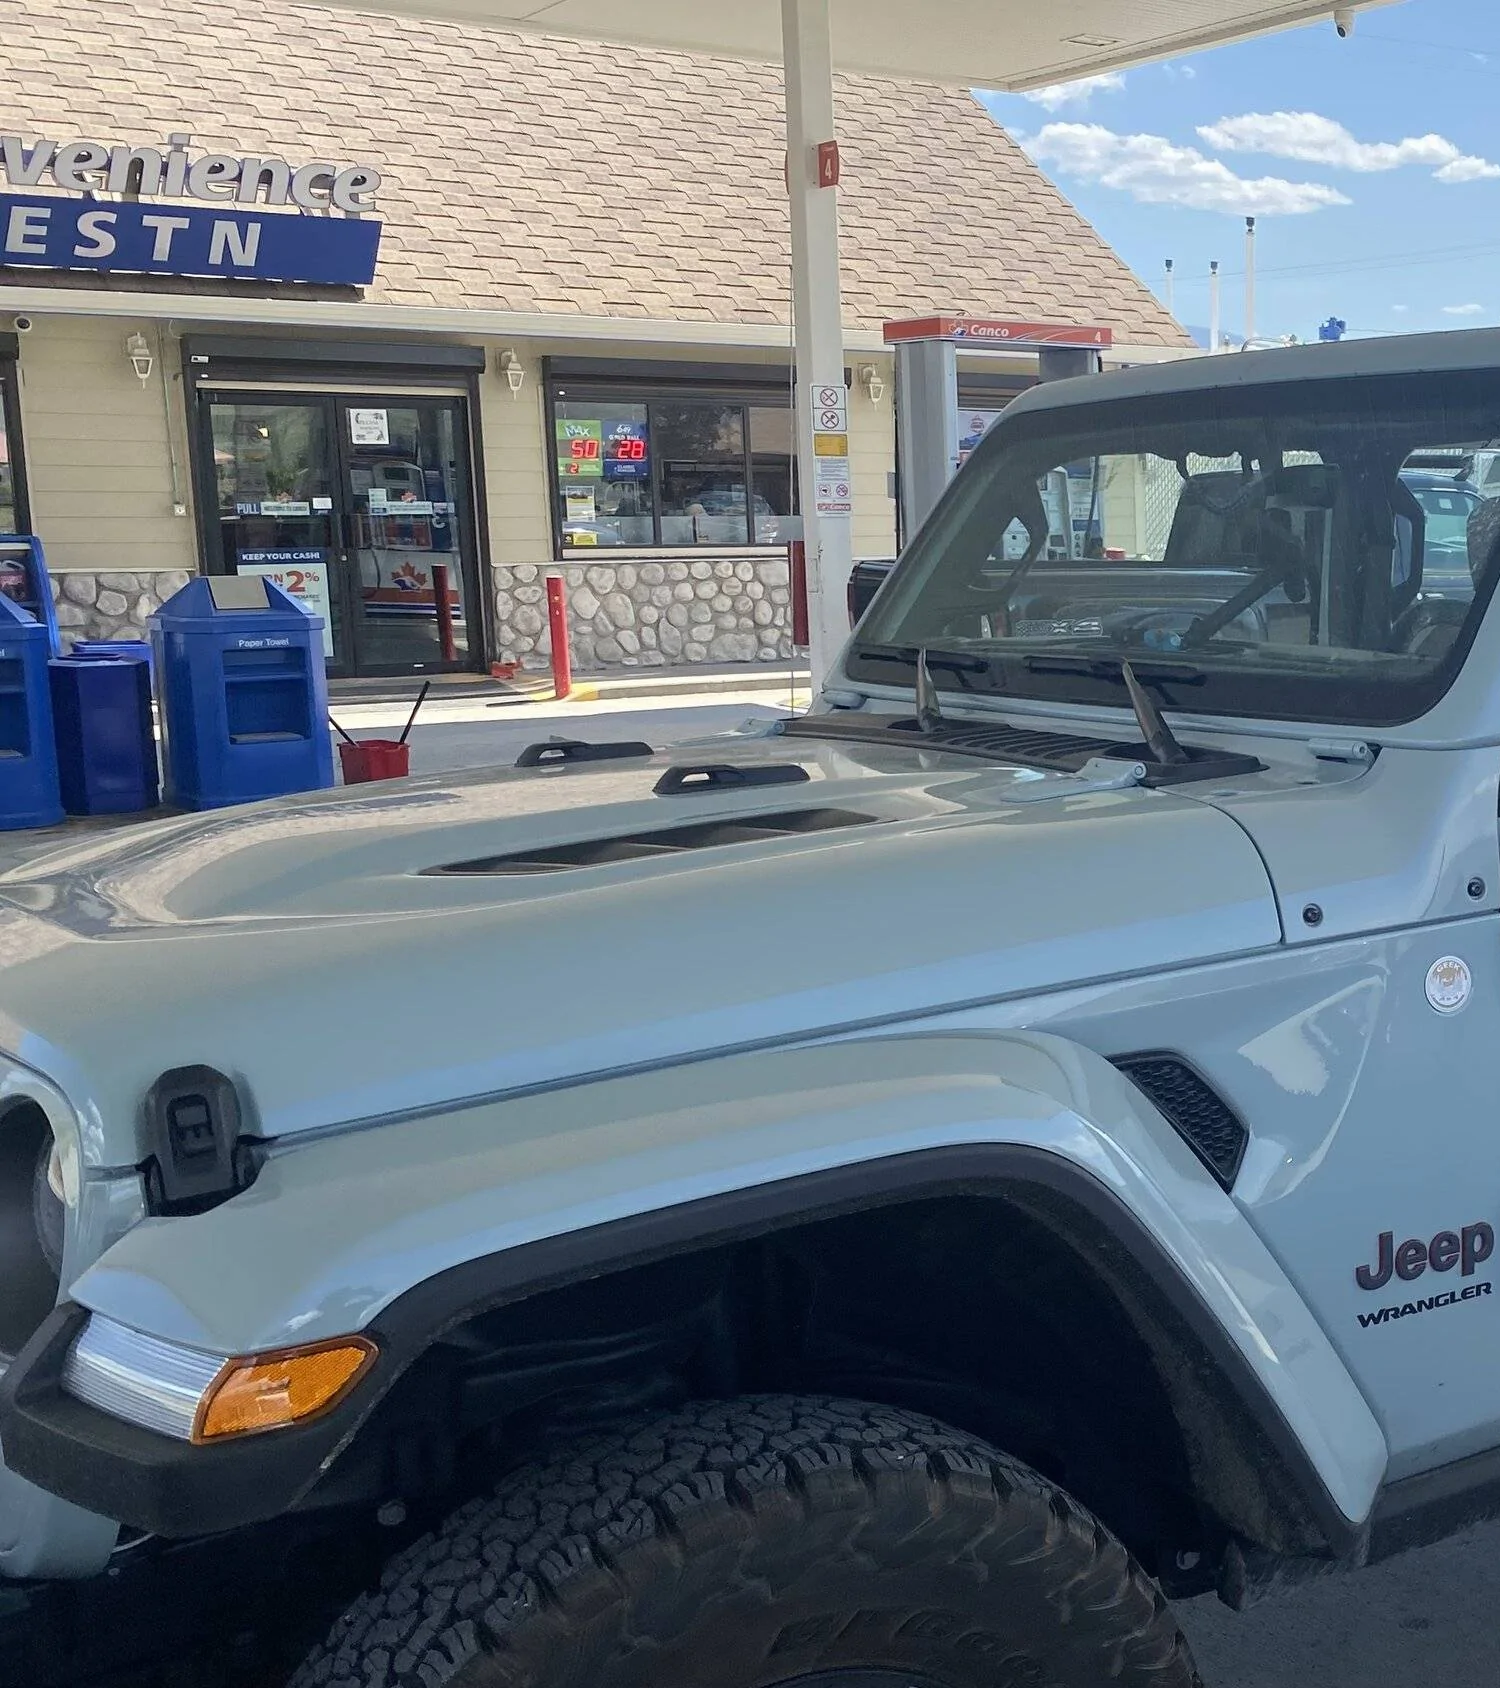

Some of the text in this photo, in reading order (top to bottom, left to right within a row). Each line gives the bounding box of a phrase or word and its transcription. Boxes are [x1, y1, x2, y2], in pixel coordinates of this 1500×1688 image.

[1, 132, 382, 213] venience
[824, 158, 833, 180] 4
[5, 205, 262, 267] ESTN
[969, 324, 1010, 338] Canco
[1094, 331, 1102, 343] 4
[572, 439, 599, 459] 50
[617, 440, 645, 459] 28
[236, 503, 260, 515] PULL
[242, 553, 265, 561] KEEP
[266, 552, 292, 560] YOUR
[238, 637, 290, 648] Paper Towel
[1436, 960, 1461, 973] GEEK
[1355, 1220, 1495, 1291] Jeep
[1357, 1281, 1493, 1328] WRANGLER
